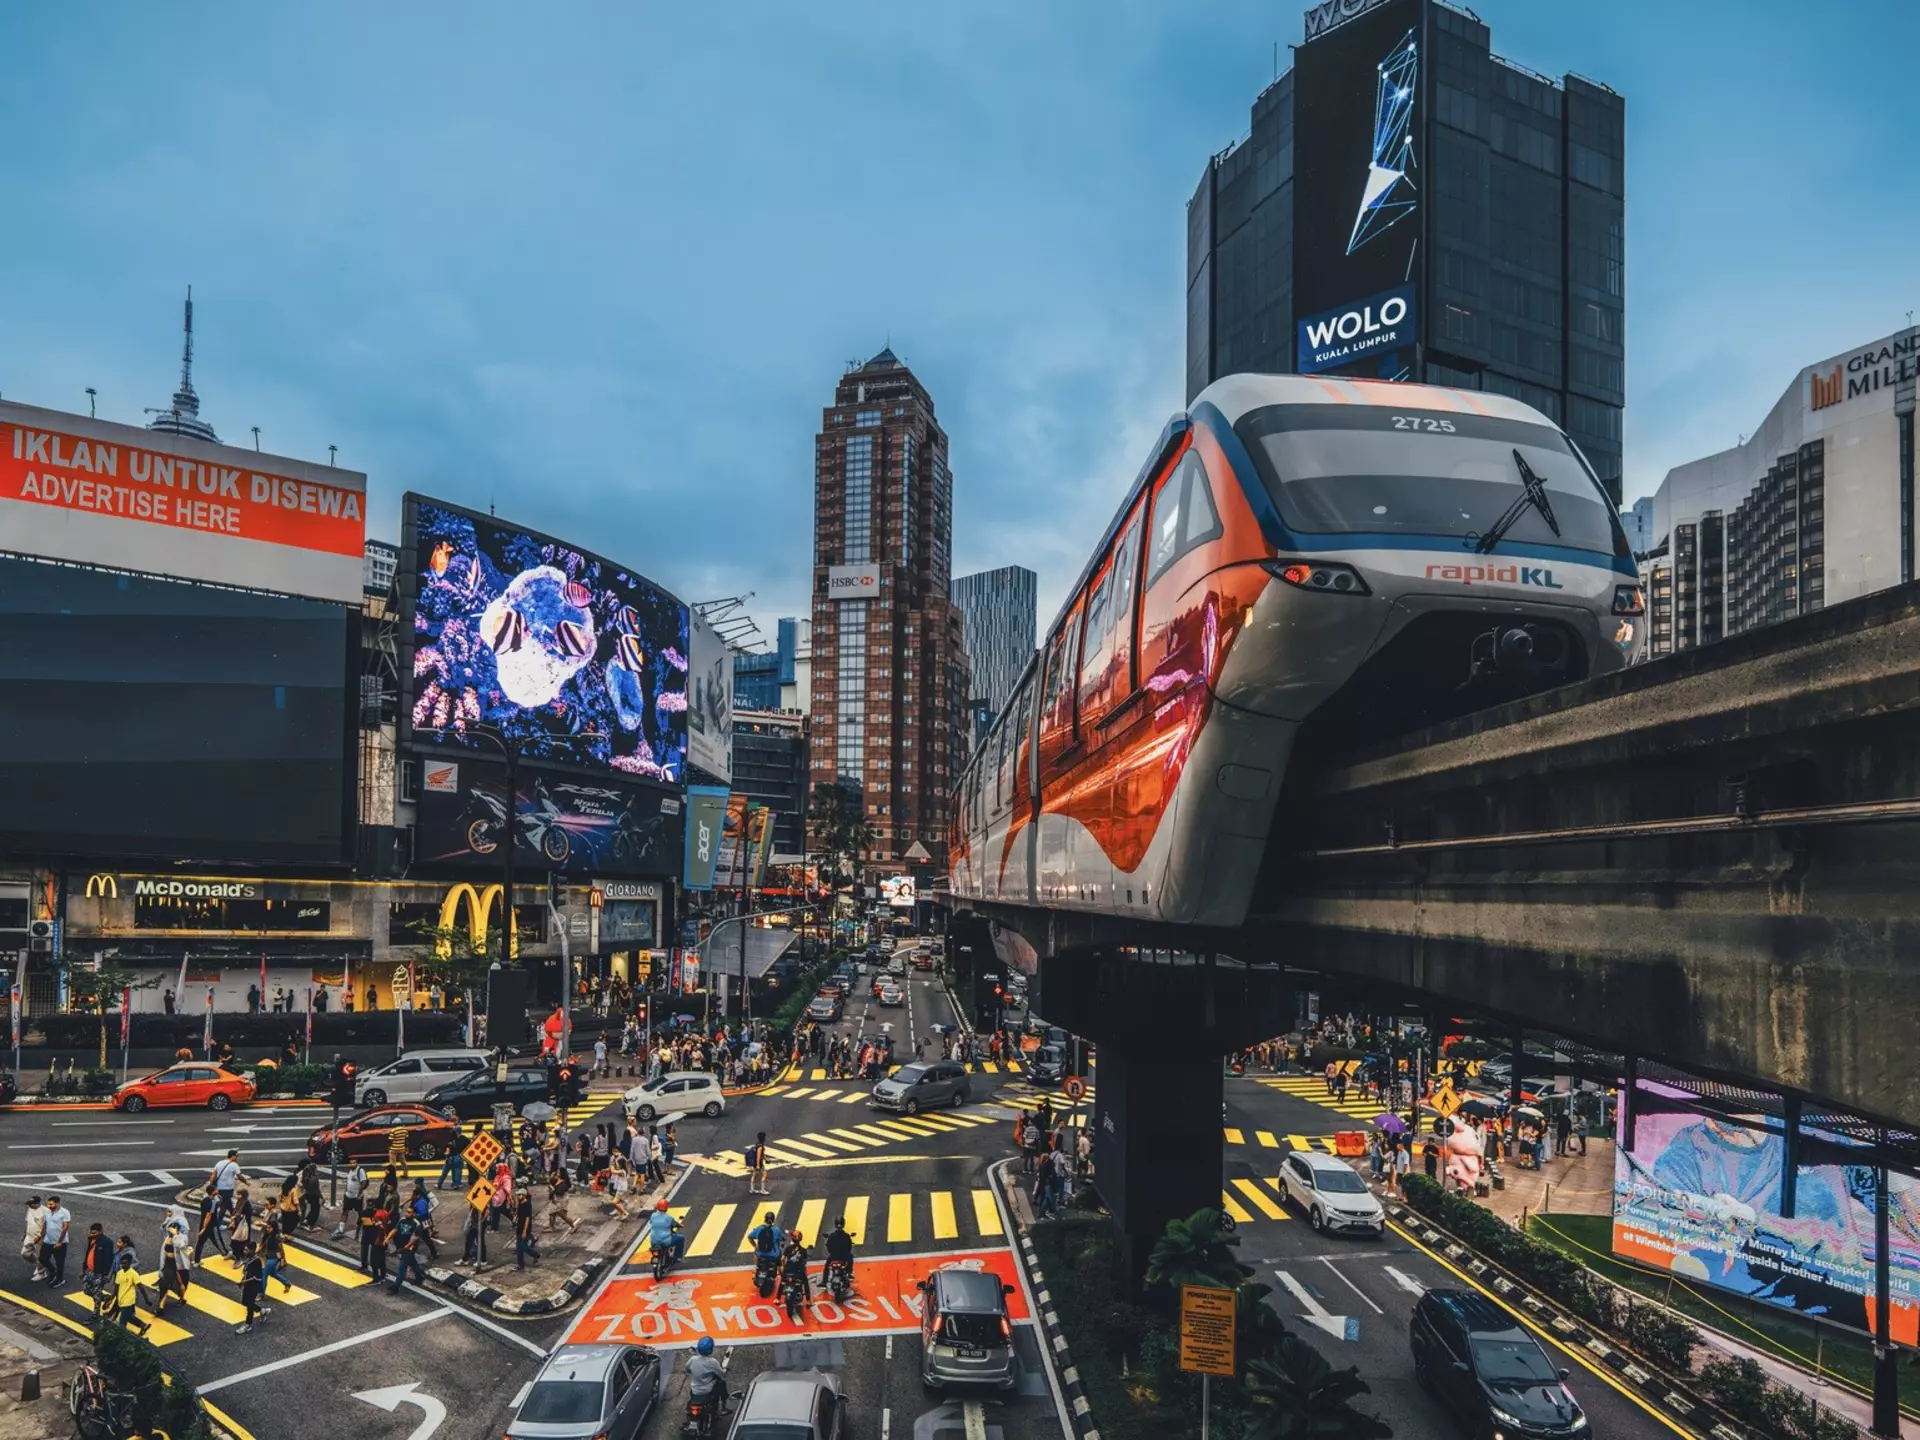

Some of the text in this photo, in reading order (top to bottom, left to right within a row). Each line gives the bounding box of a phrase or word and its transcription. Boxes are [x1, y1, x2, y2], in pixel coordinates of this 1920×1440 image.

[1306, 297, 1407, 349] WOLO
[1315, 331, 1397, 363] KUALA LUMPUR
[1391, 416, 1456, 433] 2725
[13, 428, 362, 522] IKLAN UNTUK DISEWA
[20, 471, 241, 533] ADVERTISE HERE
[831, 577, 859, 588] HSBC
[1425, 564, 1563, 590] rapidKL
[698, 820, 710, 862] acer
[135, 880, 255, 898] McDonald's
[605, 883, 654, 896] GIORDANO
[1720, 1231, 1747, 1246] Andy
[1749, 1238, 1788, 1258] Murray
[1791, 1248, 1812, 1263] has
[1814, 1258, 1870, 1280] accepted
[1781, 1261, 1824, 1283] brother
[1825, 1276, 1864, 1295] Jamie
[593, 1293, 924, 1341] ZON MOOSIK
